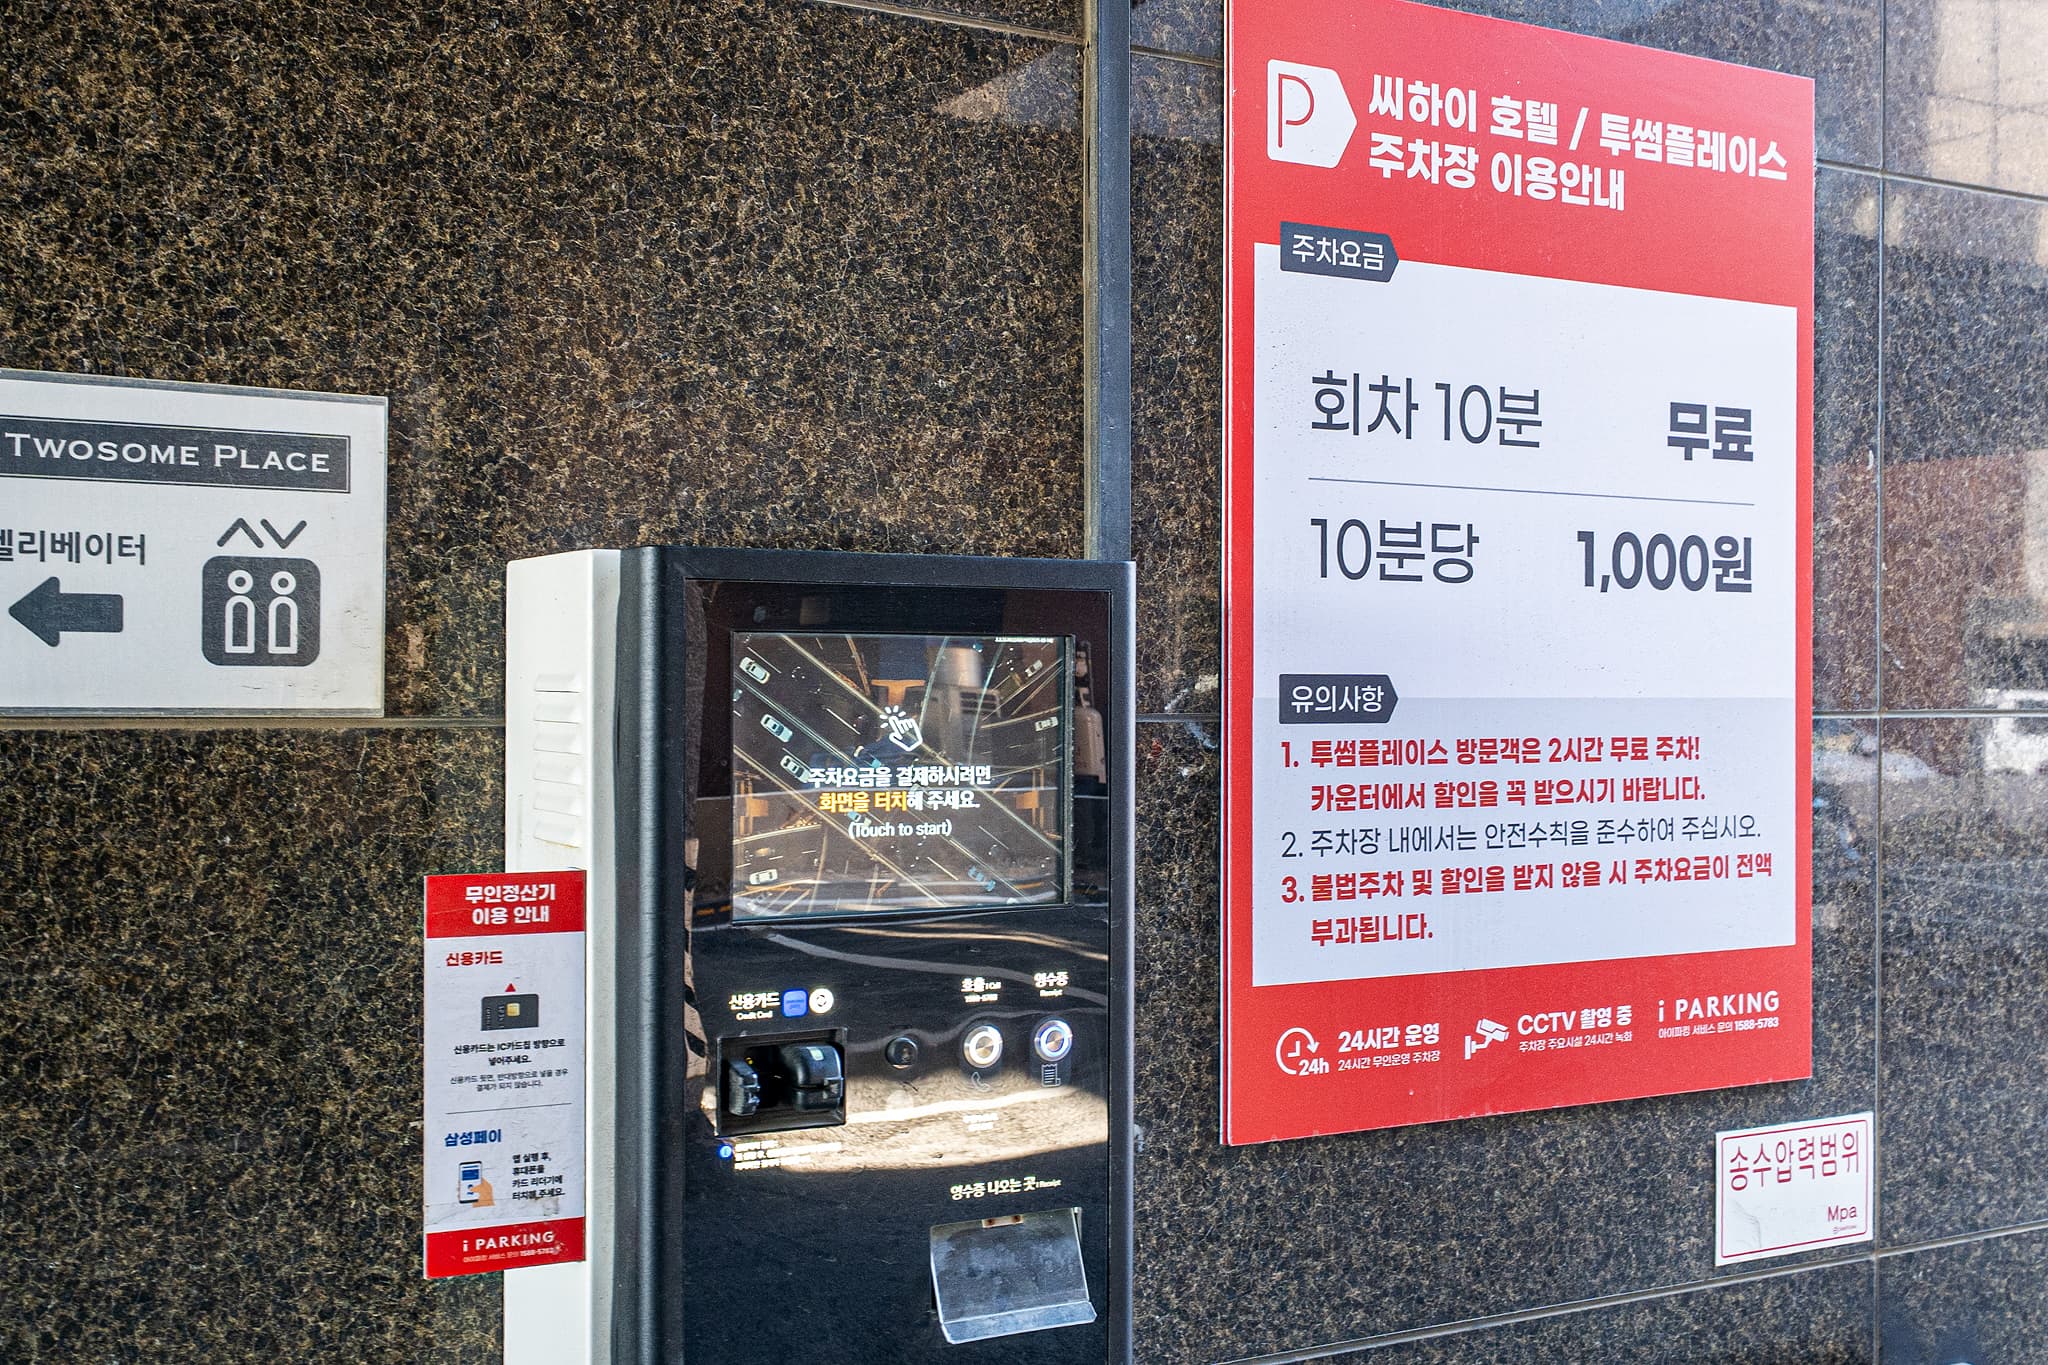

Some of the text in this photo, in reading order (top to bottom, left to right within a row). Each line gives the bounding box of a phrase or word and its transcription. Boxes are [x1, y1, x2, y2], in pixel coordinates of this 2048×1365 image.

[1368, 73, 1788, 181] 씨하이 호텔 / 투썸플레이스
[1369, 131, 1625, 211] 주차장 이용안내
[1291, 234, 1385, 271] 주차요금
[1310, 369, 1754, 462] 회차 10분 무료
[5, 432, 330, 473] TWOSOME PLACE
[1310, 517, 1753, 594] 10분당 1,000원
[1291, 685, 1385, 713] 유의사항
[1281, 735, 1700, 768] 1. 투썸플레이스 방문객은 2시간 무료 주차!
[808, 765, 991, 788] 주차요금을 결제하시려면
[819, 790, 980, 813] 화면을 터치해 주세요.
[1311, 776, 1706, 812] 카운터에서 할인을 꼭 받으시기 바랍니다.
[849, 819, 952, 839] (Touch to start)
[1281, 814, 1761, 858] 2. 주차장 내에서는 안전수칙을 준수하여 주십시오.
[1281, 852, 1772, 903] 3. 불법주차 및 할인을 받지 않을 시 주차요금이 전액
[465, 884, 556, 904] 무인정산기
[472, 906, 549, 925] 이용 안내
[1311, 913, 1433, 947] 부과됩니다.
[445, 951, 503, 967] 신용카드
[1034, 971, 1069, 988] 영수증
[728, 991, 780, 1010] 신용카드
[1675, 990, 1779, 1020] PARKING
[1517, 1005, 1632, 1035] CCTV 촬영 중
[1658, 1025, 1690, 1039] 아이파킹
[1692, 1023, 1716, 1035] 서비스
[1735, 1017, 1779, 1031] 1588-5783
[454, 1043, 496, 1055] 신용카드는
[1338, 1023, 1440, 1052] 24시간 운영
[1519, 1039, 1546, 1052] 주차장
[1547, 1035, 1582, 1050] 주요시설
[1584, 1033, 1614, 1046] 24시간
[1298, 1057, 1330, 1077] 24h
[1338, 1050, 1441, 1072] 24시간 무인운영 주차장
[444, 1129, 502, 1147] 삼성페이
[1729, 1130, 1859, 1191] 송수압력범위
[950, 1182, 986, 1200] 영수증
[987, 1178, 1022, 1195] 나오는
[1827, 1205, 1857, 1222] Mpa
[475, 1231, 555, 1251] PARKING
